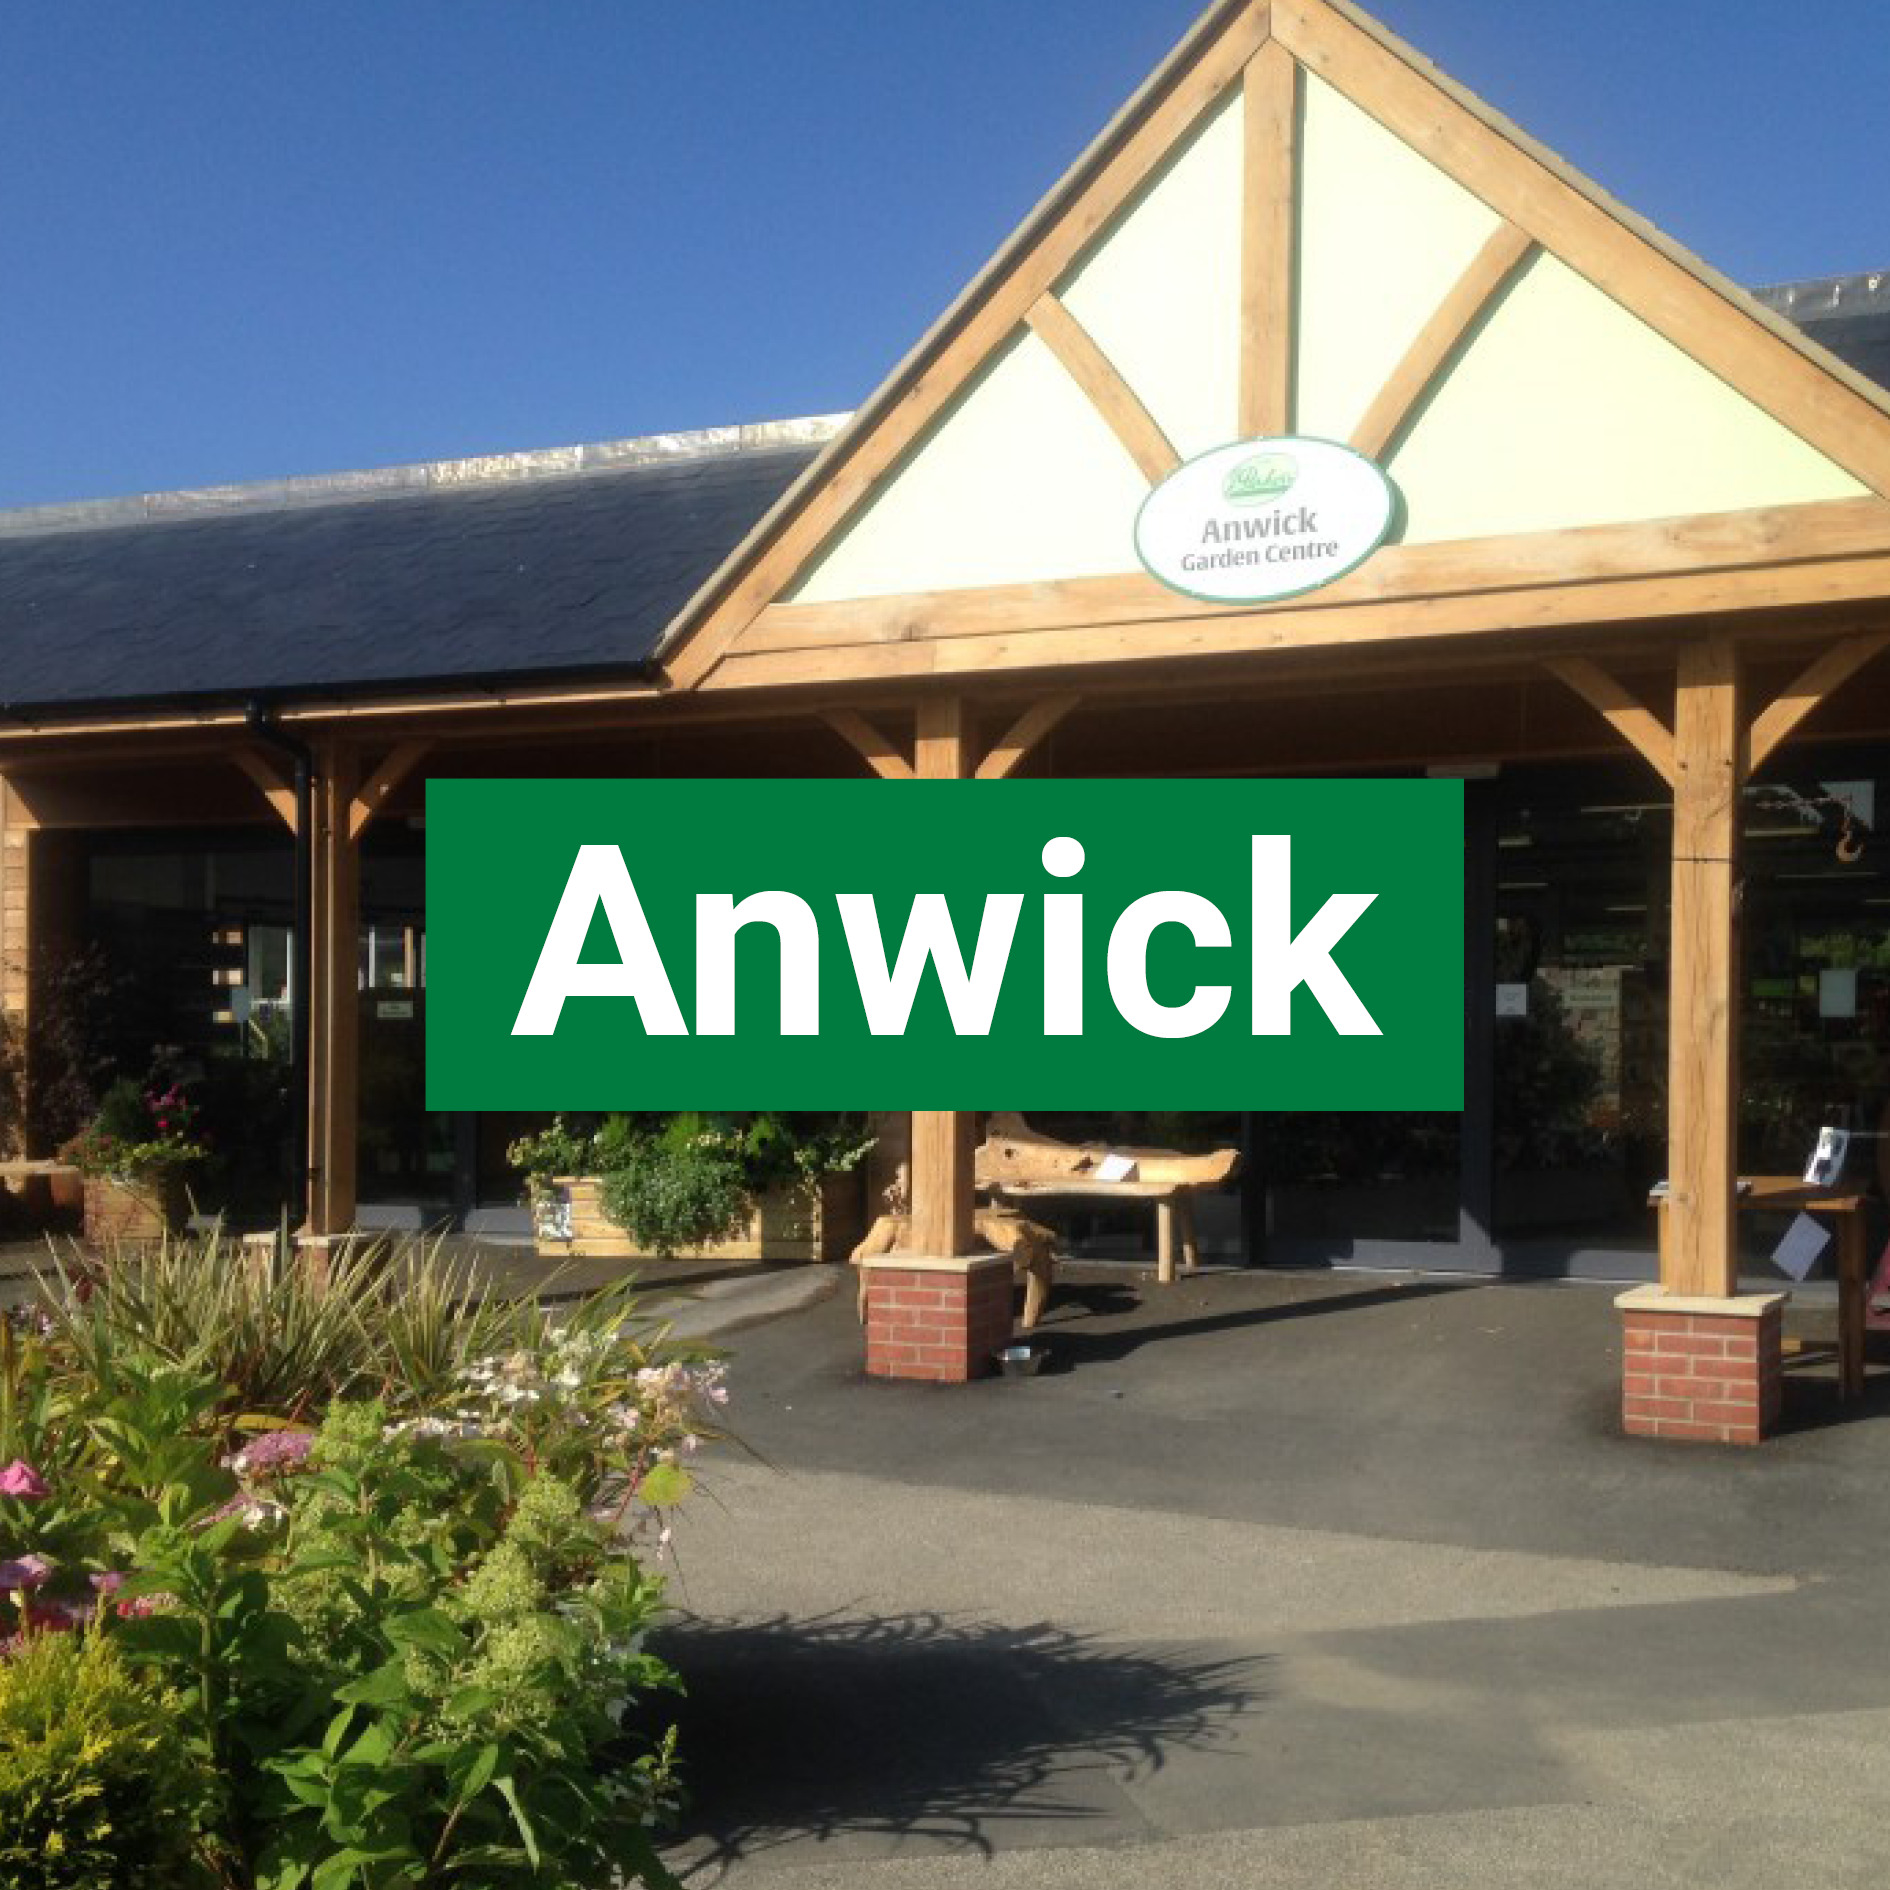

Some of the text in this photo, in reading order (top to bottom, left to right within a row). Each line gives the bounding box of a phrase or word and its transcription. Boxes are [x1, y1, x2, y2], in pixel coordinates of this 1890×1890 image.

[1201, 506, 1319, 544] Anwick
[1181, 539, 1339, 572] Garden Centre
